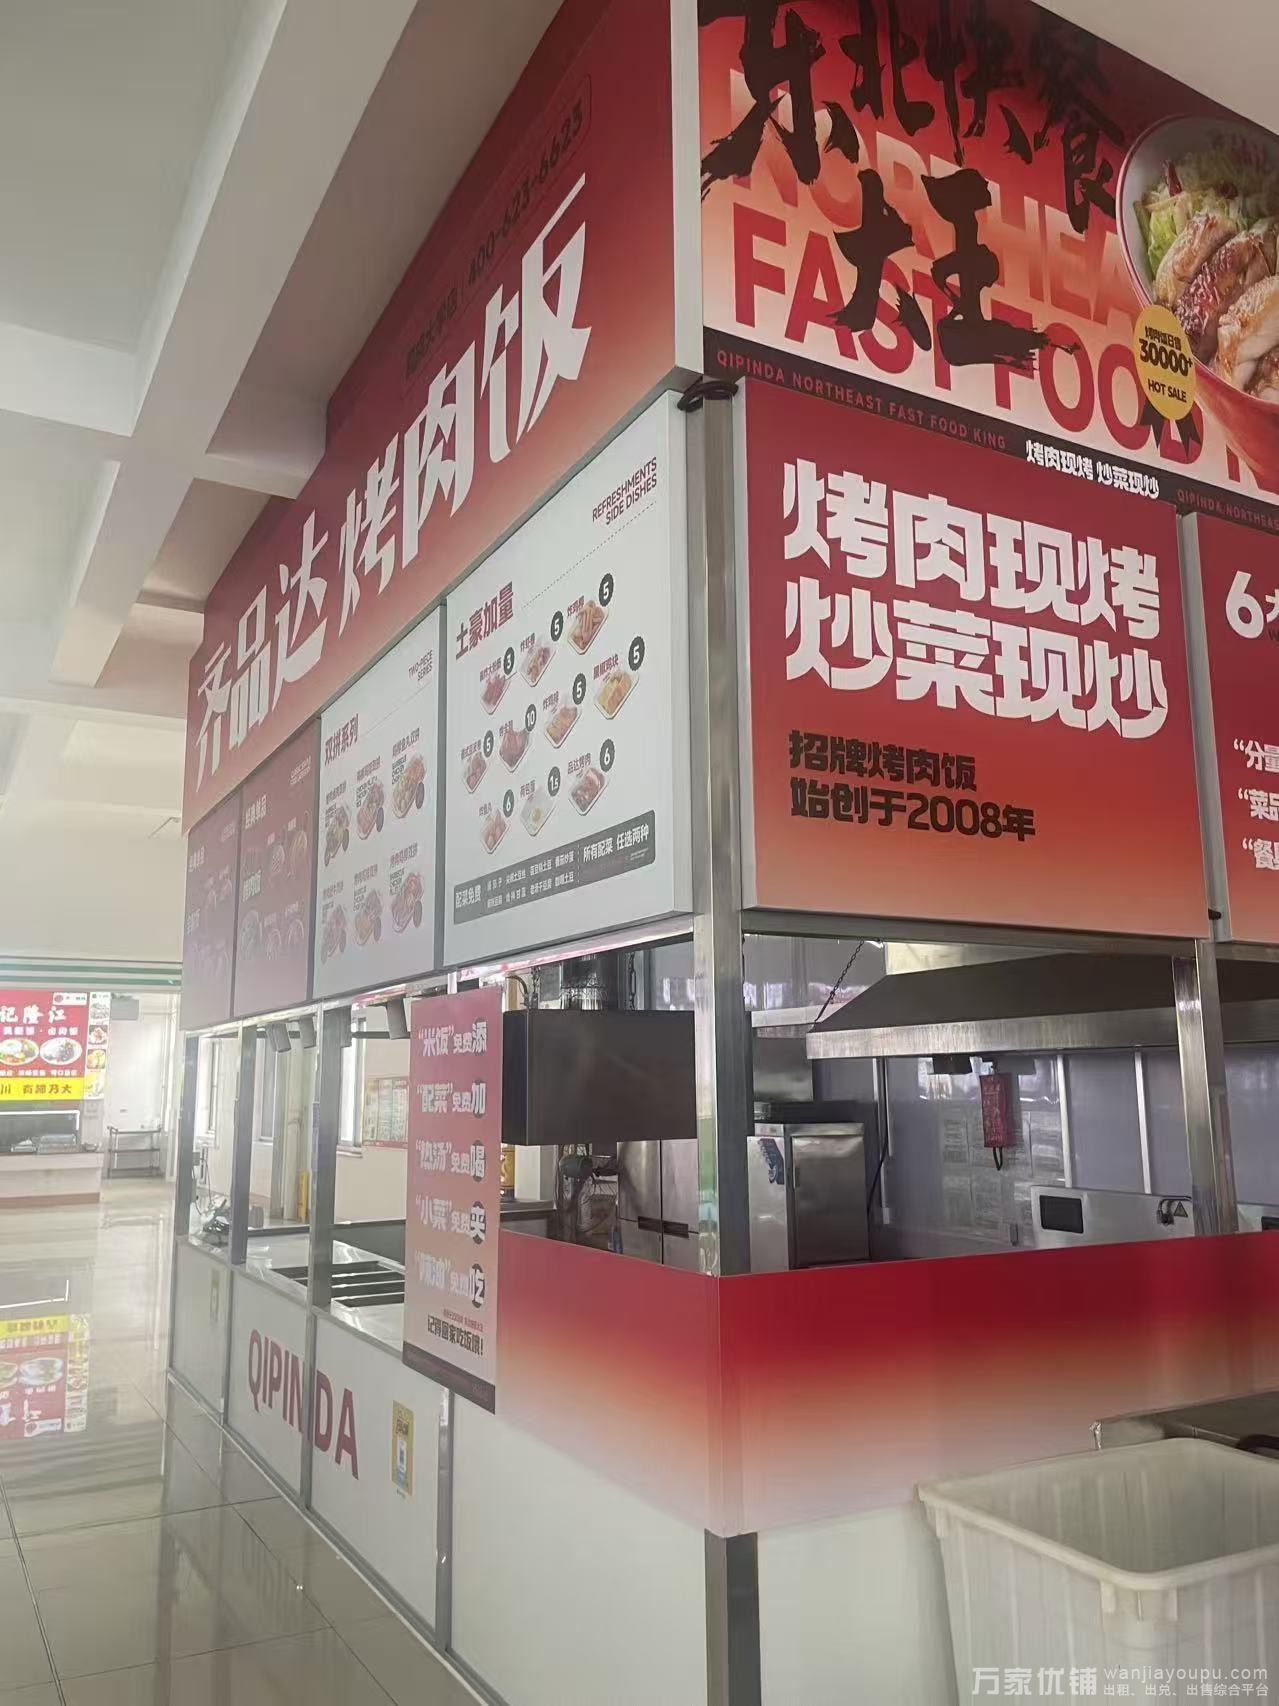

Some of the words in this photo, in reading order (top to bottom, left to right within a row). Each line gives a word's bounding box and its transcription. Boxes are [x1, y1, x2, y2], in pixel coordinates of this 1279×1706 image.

[826, 168, 1080, 366] 大王
[1139, 338, 1193, 377] 30000+
[717, 350, 785, 383] QIPINDA
[792, 374, 882, 412] NORTHEAST
[889, 403, 925, 425] FAST
[930, 415, 968, 438] FOOD
[973, 428, 1006, 450] KING
[1148, 378, 1166, 395] HOT
[1168, 386, 1187, 403] SALE
[196, 172, 592, 792] 齐品达烤肉饭
[1025, 439, 1093, 482] 烤肉现烤
[1096, 459, 1160, 500] 炒菜现炒
[592, 456, 657, 523] REFRESHMENTS
[605, 503, 624, 526] SIDE
[625, 473, 657, 517] DISHES
[1177, 490, 1222, 512] QIPINDA
[783, 458, 1160, 641] 烤肉现烤
[602, 582, 610, 599] 5
[455, 580, 514, 660] 土豪加量
[554, 619, 560, 635] 5
[506, 653, 512, 668] 3
[633, 644, 640, 662] 5
[785, 577, 1169, 740] 炒菜现炒
[576, 682, 582, 699] 5
[526, 712, 535, 726] 10
[325, 712, 359, 766] 双拼系列
[485, 737, 491, 751] 5
[603, 748, 610, 764] 6
[788, 730, 978, 792] 招牌烤肉饭
[505, 796, 511, 811] 6
[790, 777, 1036, 842] 始创于2008年
[583, 837, 613, 863] 所有配菜
[616, 823, 650, 851] 任选两种
[1242, 837, 1279, 871] “餐
[455, 884, 482, 909] 配菜免费
